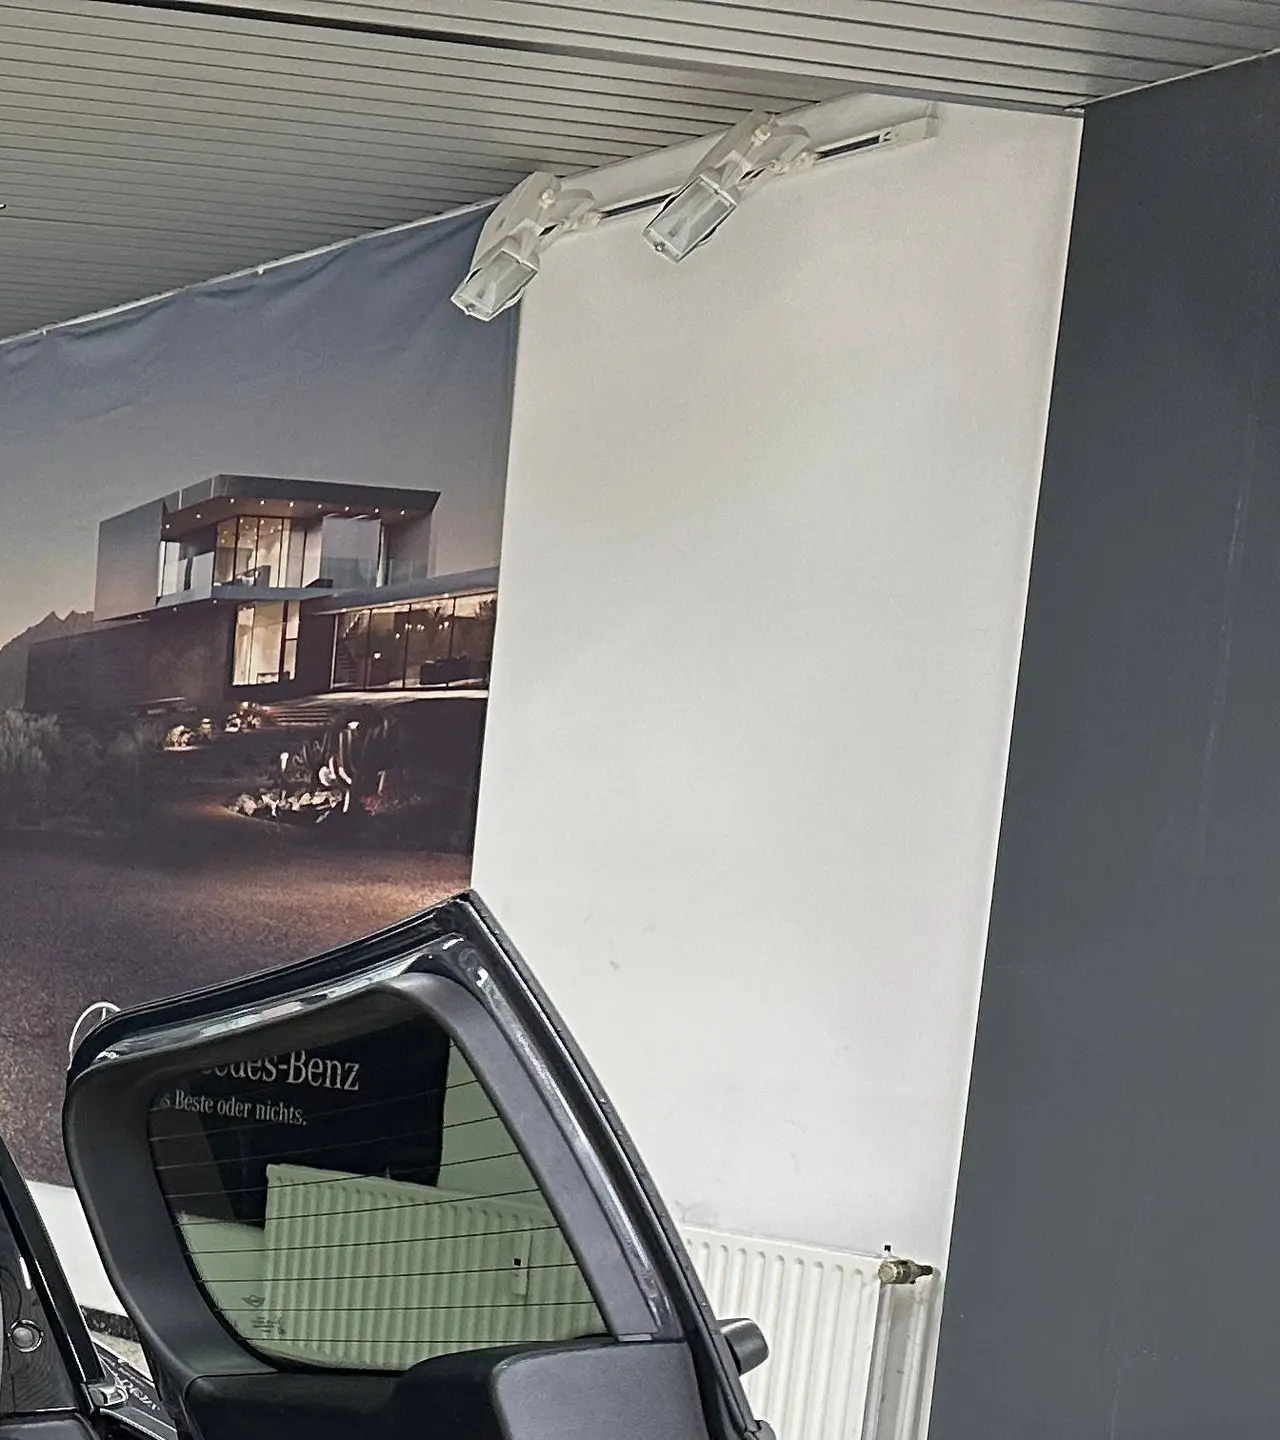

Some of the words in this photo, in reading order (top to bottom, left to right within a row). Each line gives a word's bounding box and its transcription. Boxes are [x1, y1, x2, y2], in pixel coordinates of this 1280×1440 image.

[175, 1088, 214, 1115] Beste
[217, 1096, 252, 1120] oder
[255, 1100, 307, 1126] nichts.
